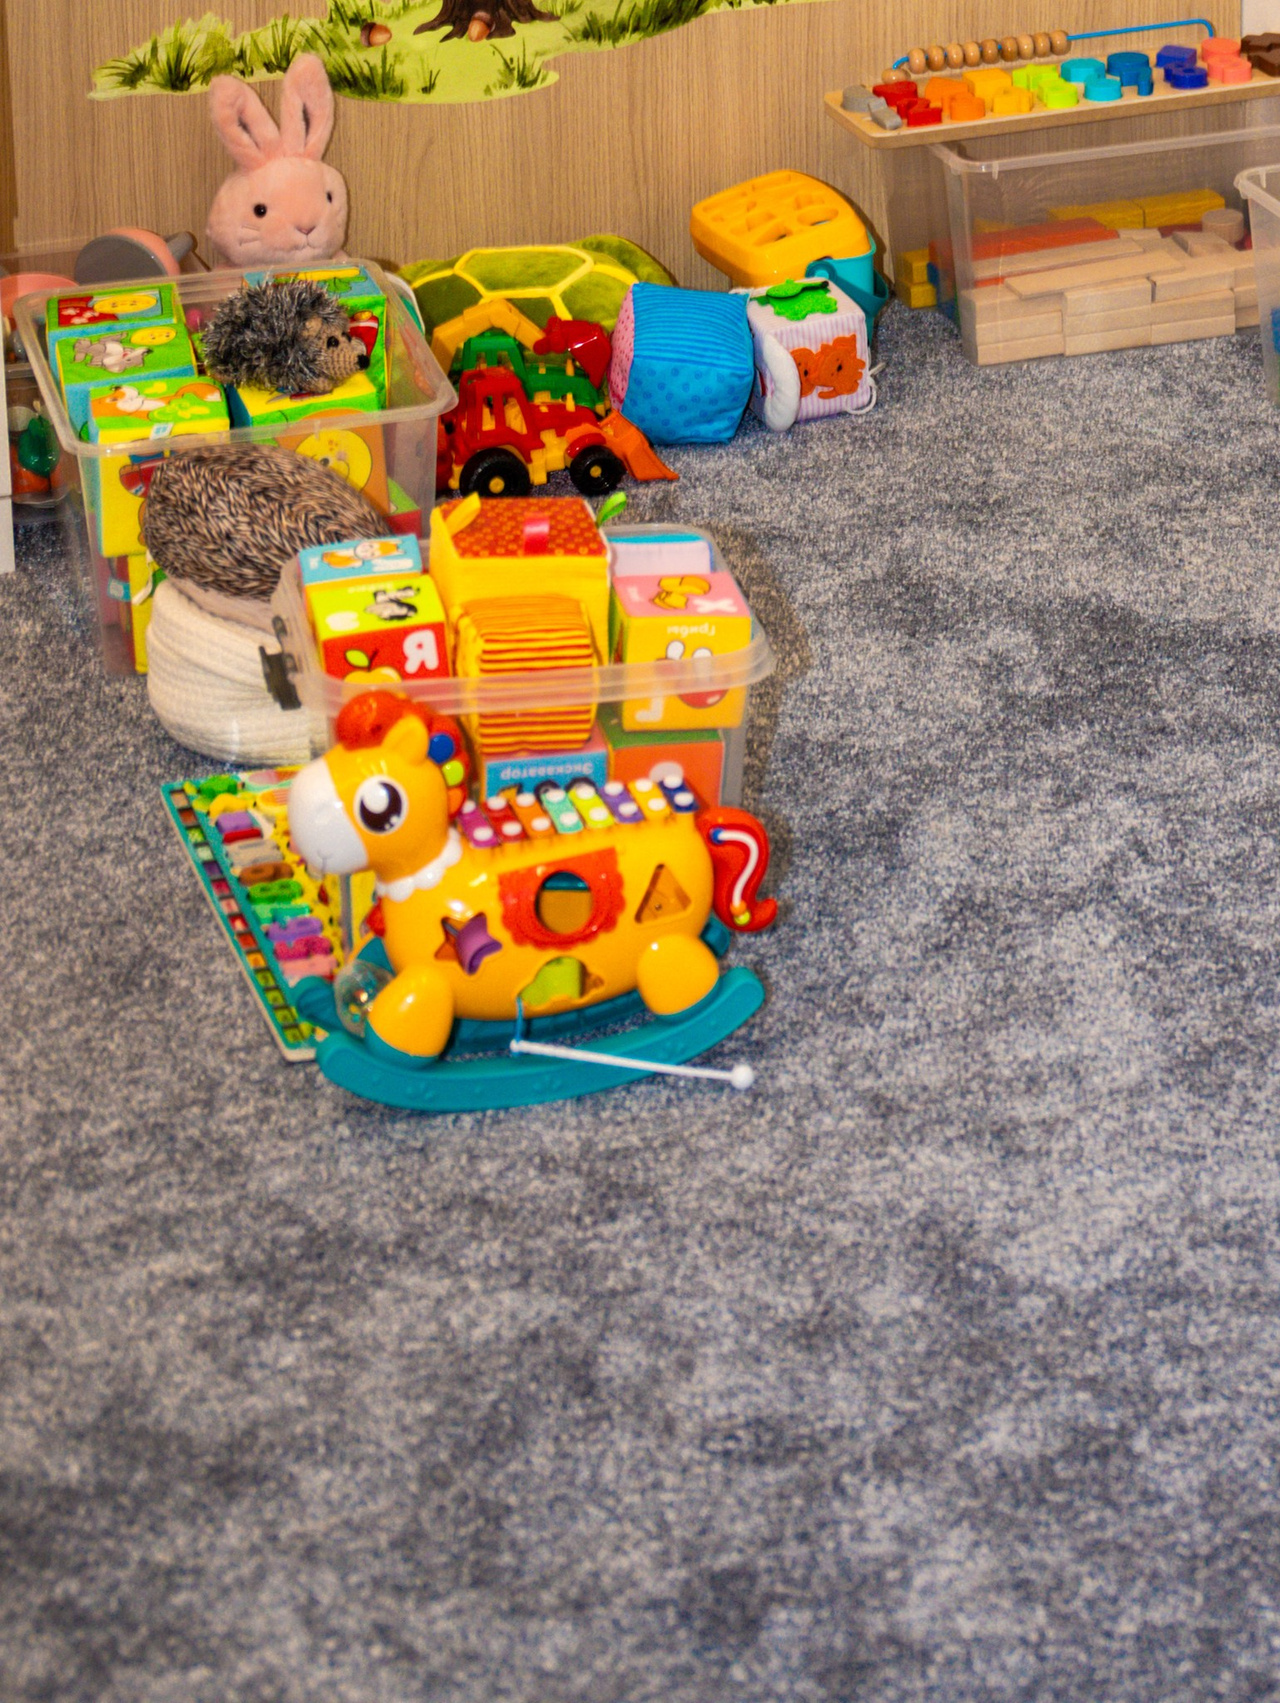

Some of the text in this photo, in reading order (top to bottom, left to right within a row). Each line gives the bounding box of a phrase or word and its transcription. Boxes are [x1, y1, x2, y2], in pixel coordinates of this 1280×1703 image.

[667, 622, 716, 637] Грибы
[403, 629, 439, 674] Я
[500, 761, 594, 781] Экскаватор
